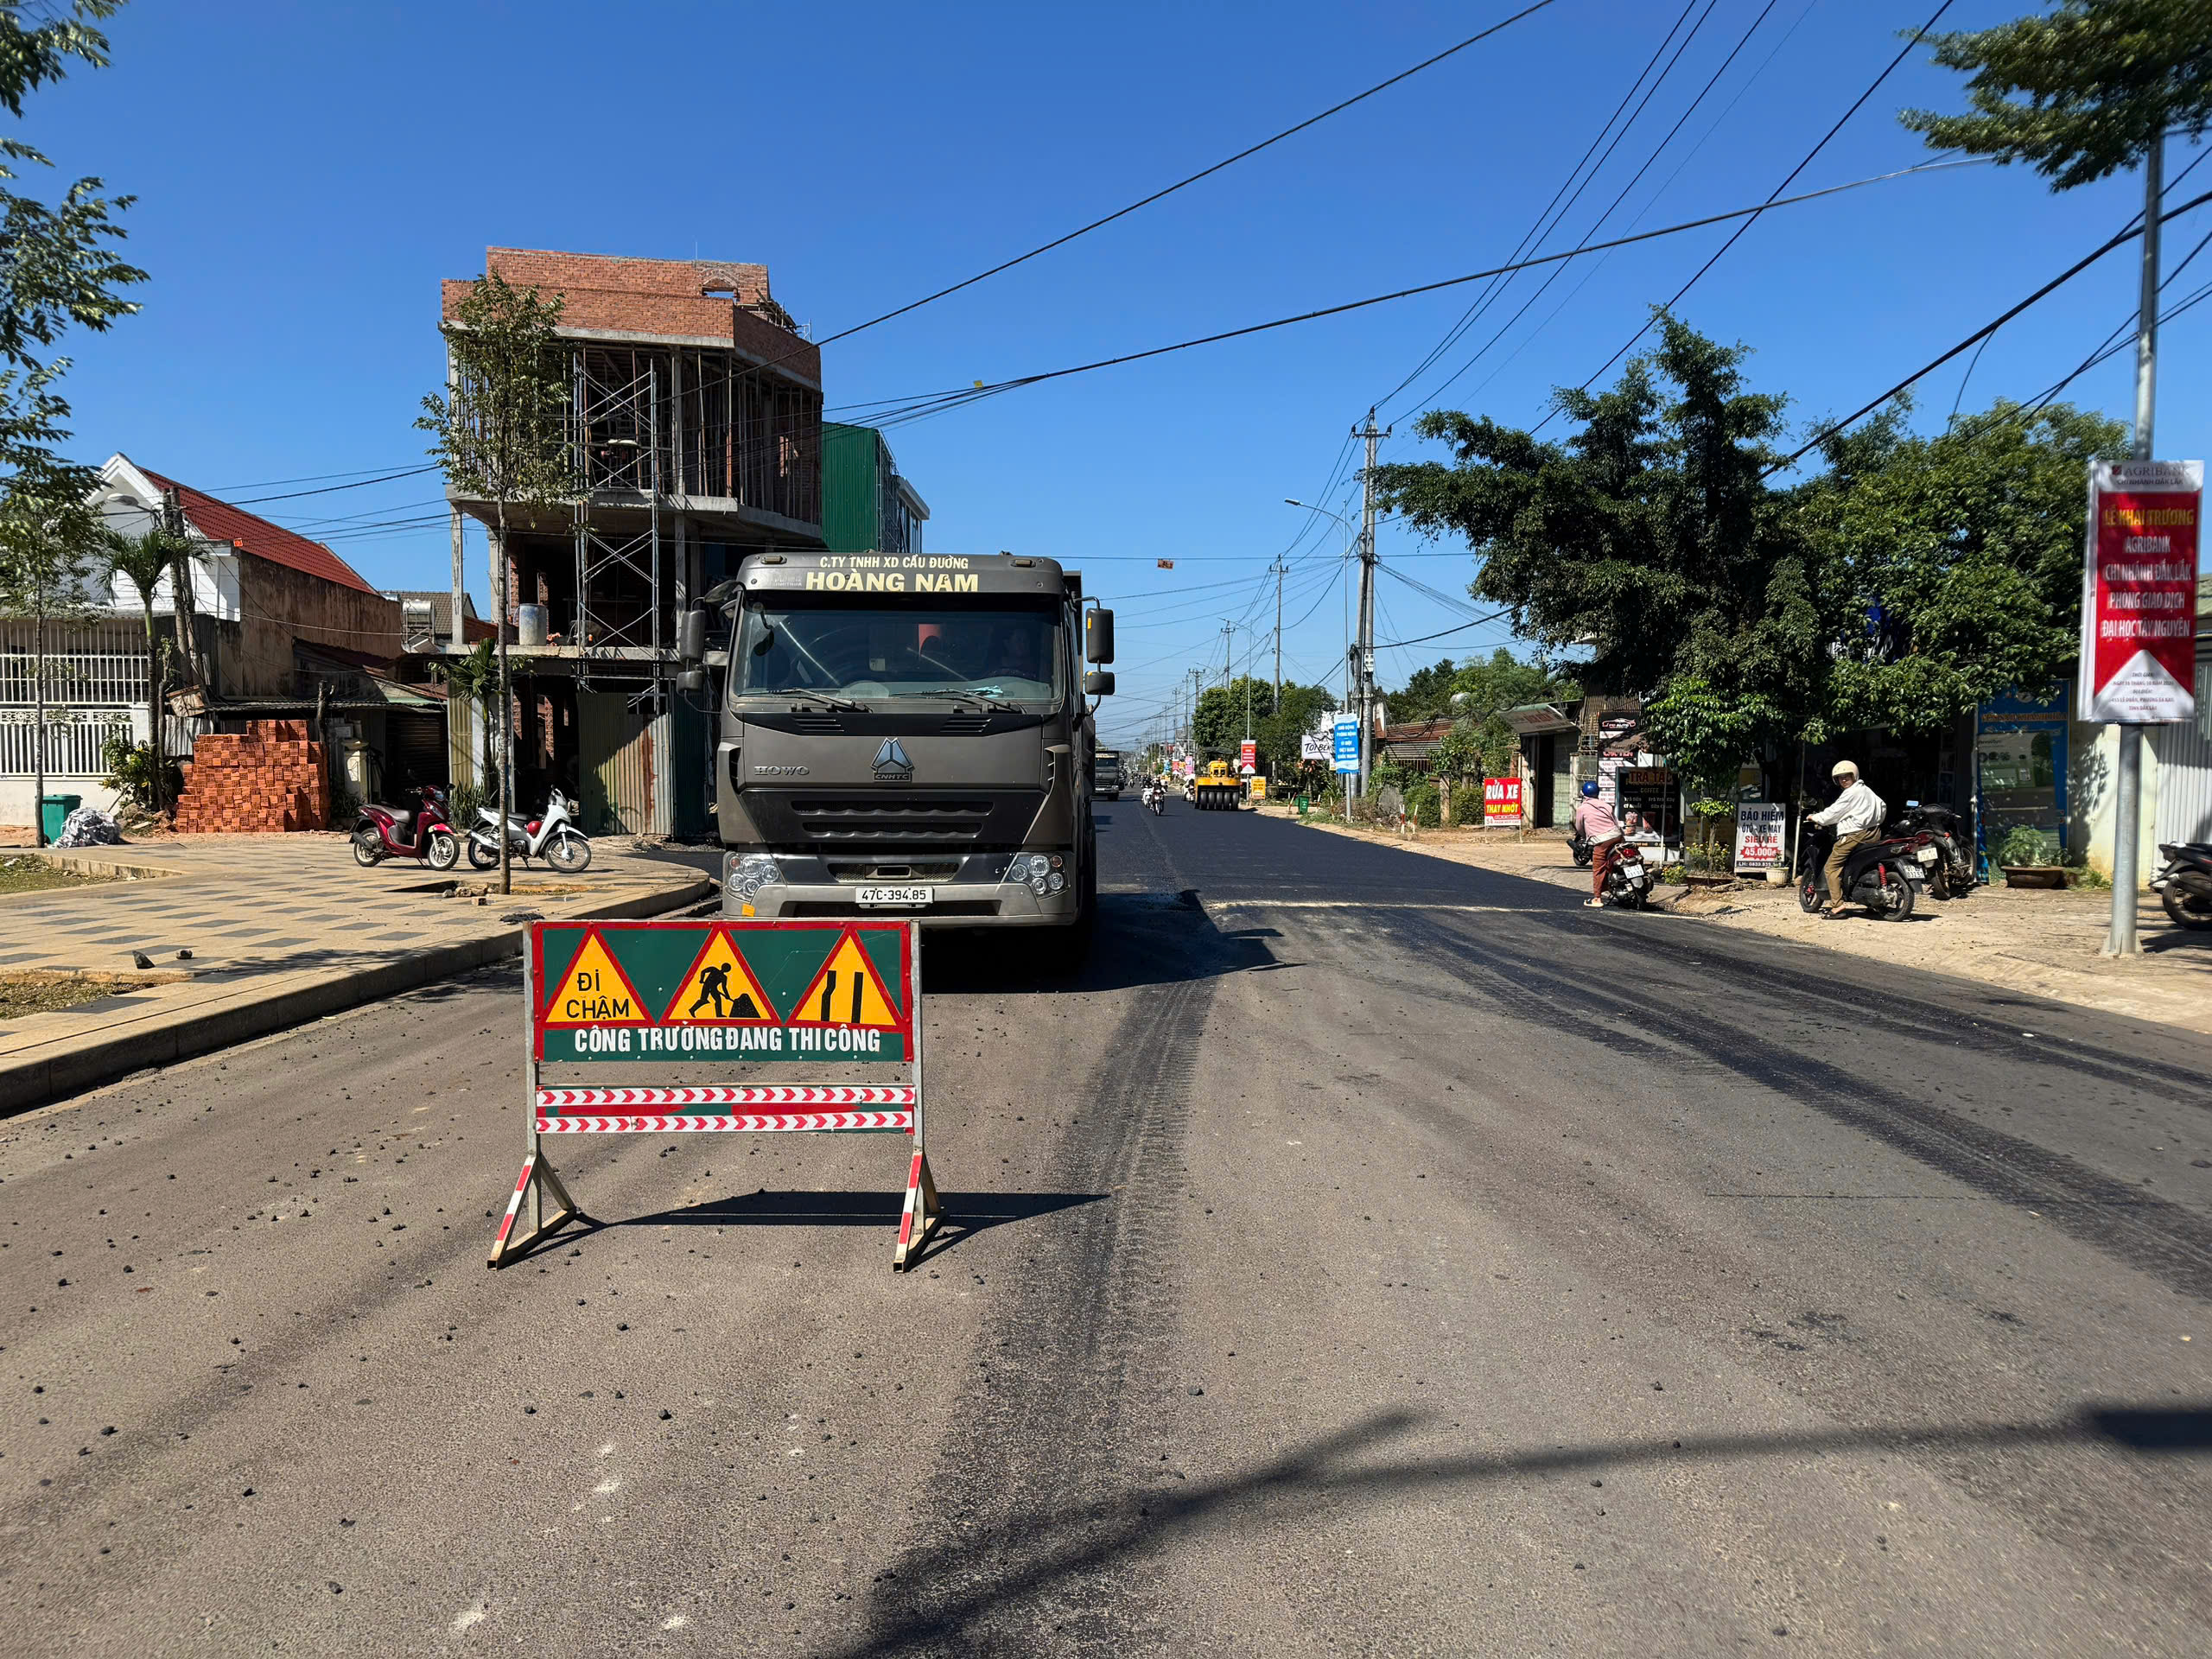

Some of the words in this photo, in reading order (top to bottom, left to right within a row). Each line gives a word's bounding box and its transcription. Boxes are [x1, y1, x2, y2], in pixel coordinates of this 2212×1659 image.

[2118, 508, 2145, 526] KHAI
[2126, 536, 2171, 553] AGRIBANK
[849, 556, 880, 568] TNHH
[883, 557, 899, 568] XD
[805, 569, 905, 592] HOÀNG
[914, 573, 978, 592] NAM
[753, 766, 810, 776] HOWO
[1486, 779, 1503, 800] RỬA
[1506, 784, 1519, 799] XE
[1486, 804, 1501, 814] THAY
[1741, 808, 1758, 821] BẢO
[1758, 824, 1767, 833] XE
[861, 889, 926, 900] 47C-394.85
[577, 969, 601, 992] ĐI
[566, 995, 629, 1020] CHẬM
[575, 1025, 631, 1052] CÔNG
[638, 1020, 722, 1051] TRƯỜNG
[725, 1027, 782, 1051] ĐANG
[789, 1027, 821, 1051] THI
[824, 1023, 880, 1052] CÔNG
